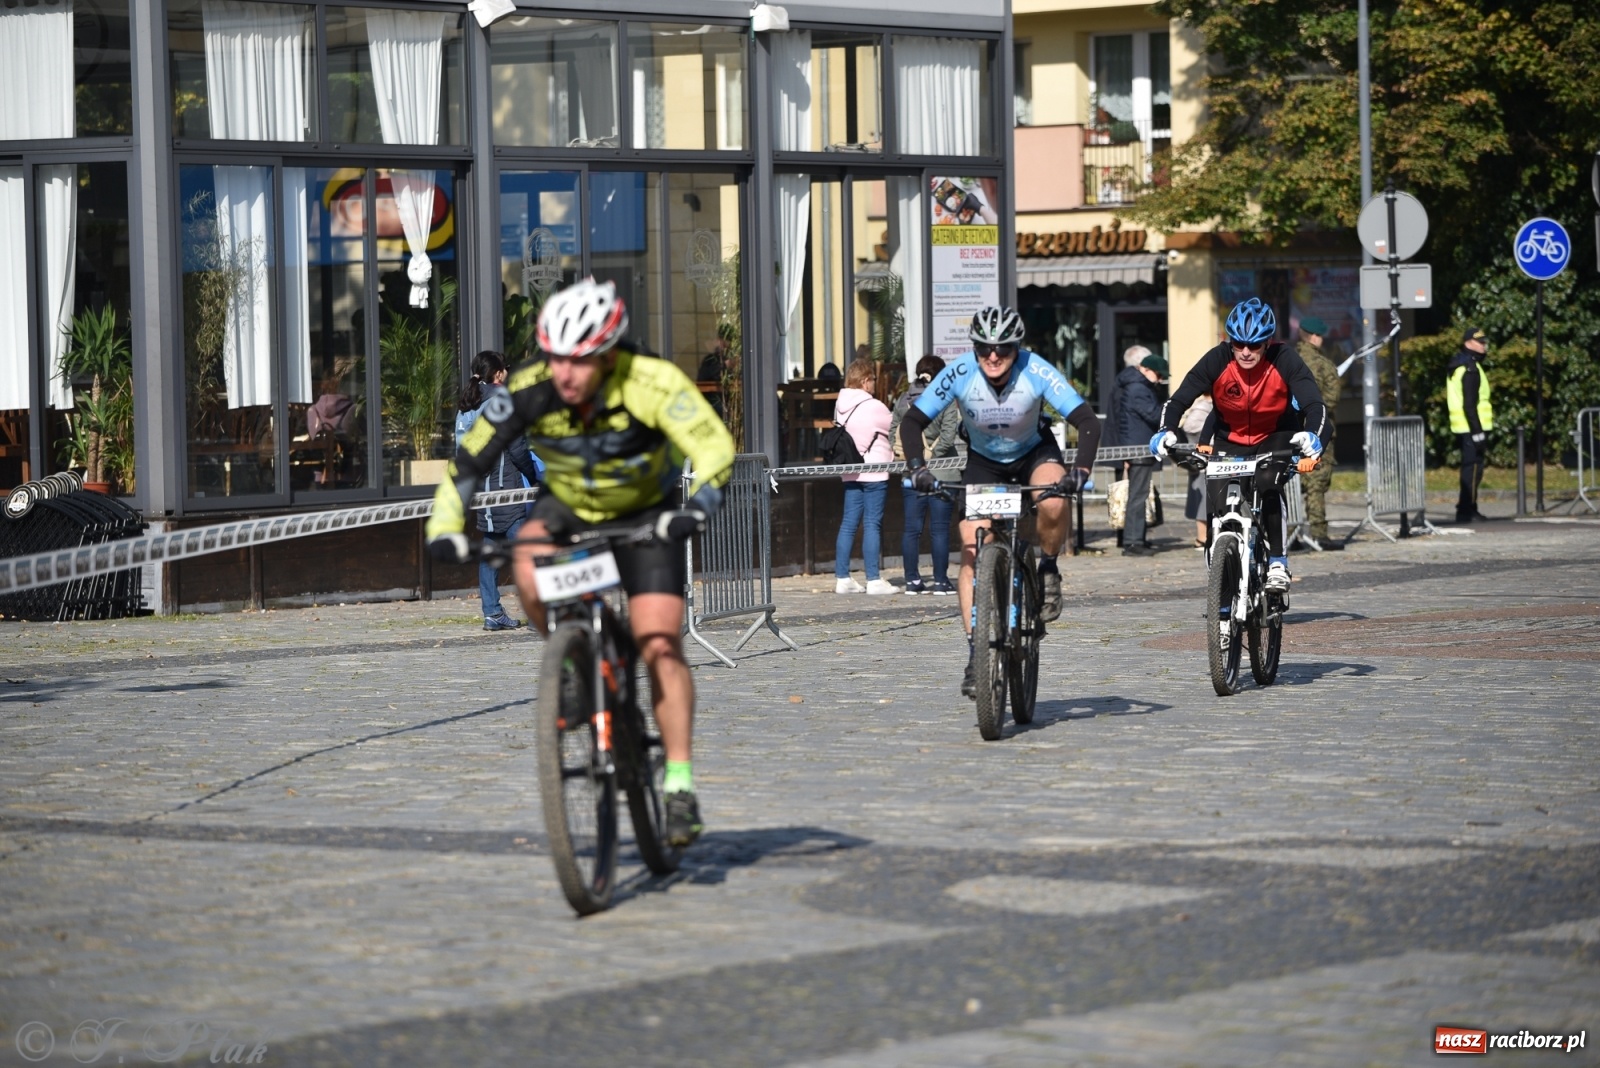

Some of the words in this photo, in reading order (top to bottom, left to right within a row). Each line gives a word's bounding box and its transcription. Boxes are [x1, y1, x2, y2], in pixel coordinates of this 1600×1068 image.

[932, 228, 959, 244] CATERING
[960, 228, 997, 244] DIETETYCZNY
[960, 248, 970, 259] BEZ
[934, 362, 968, 401] SCHC
[1028, 361, 1067, 396] SCHC
[1215, 464, 1248, 473] 2898
[976, 498, 1012, 511] 2255
[552, 563, 604, 591] 1049
